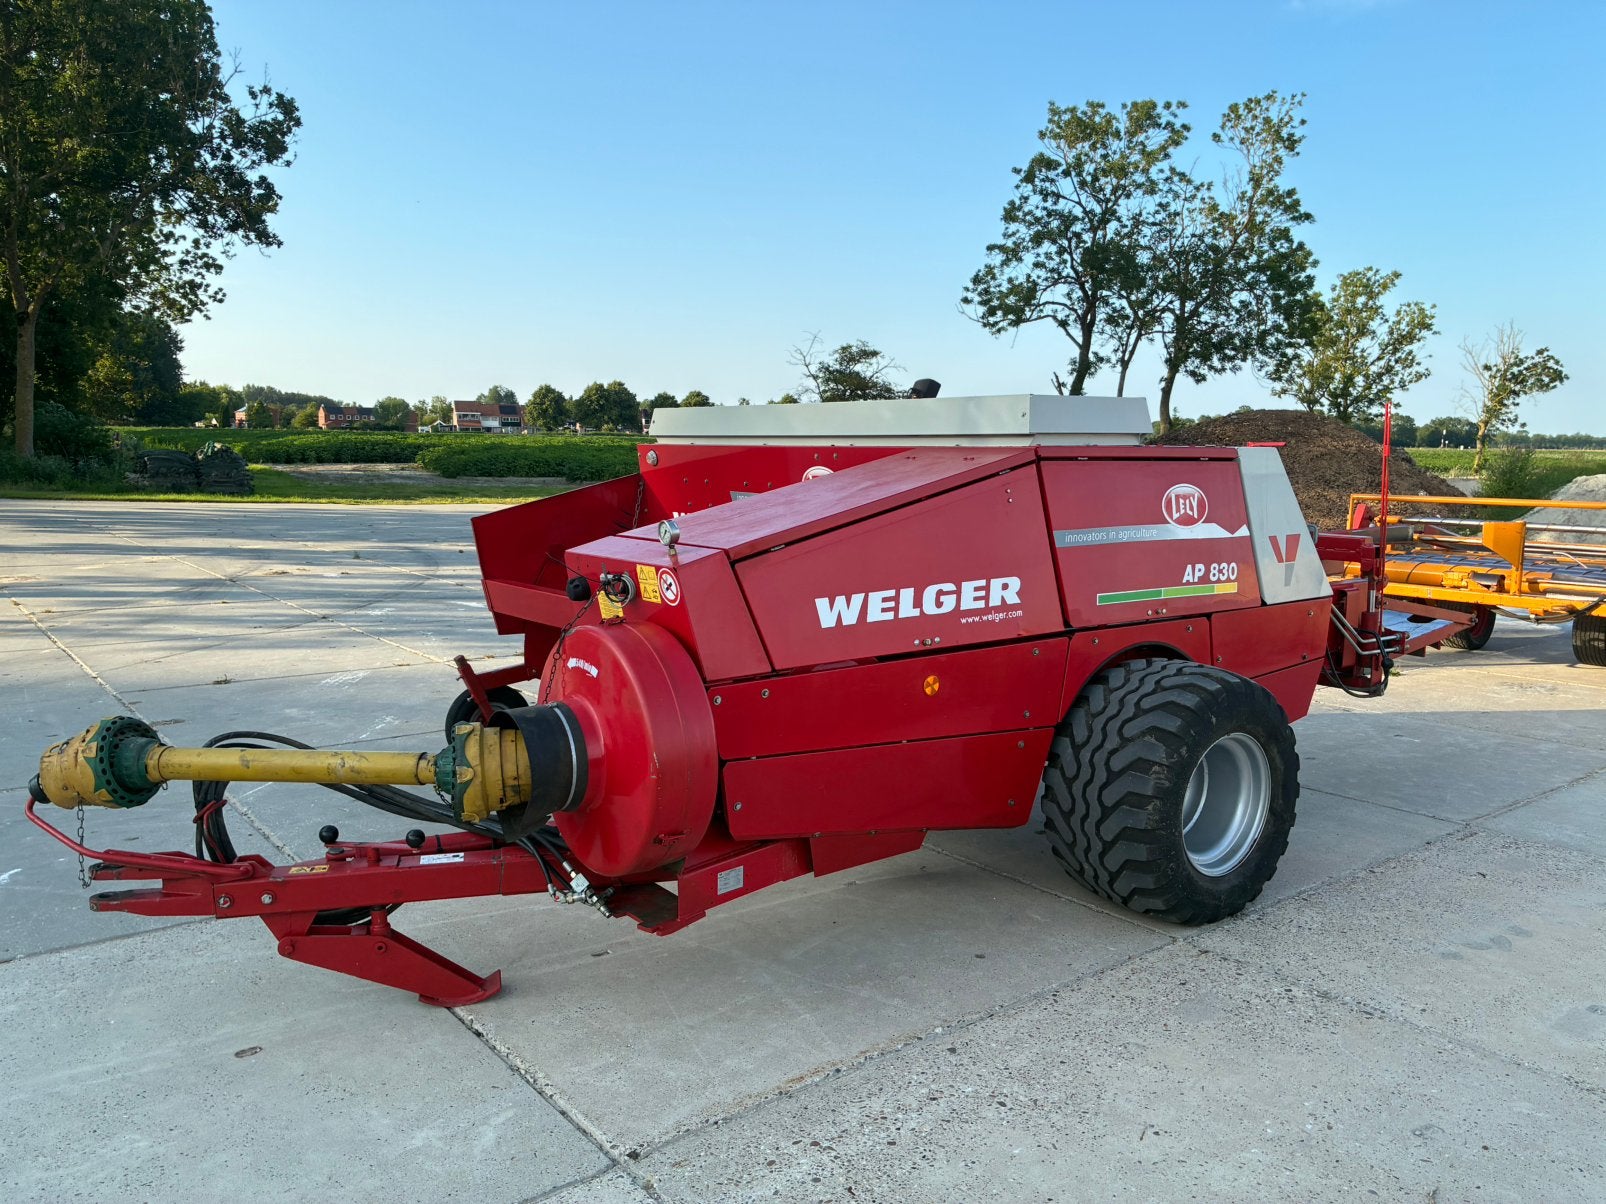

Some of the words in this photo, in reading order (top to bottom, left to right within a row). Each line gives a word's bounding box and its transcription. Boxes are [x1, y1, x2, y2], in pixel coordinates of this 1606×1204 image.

[1171, 493, 1198, 520] LELY
[1065, 532, 1107, 543] innovators
[1109, 529, 1116, 539] in
[1119, 528, 1157, 540] agriculture
[1182, 564, 1205, 583] AP
[1209, 562, 1238, 582] 830
[814, 576, 1022, 629] WELGER
[960, 610, 1023, 624] www.welger.com
